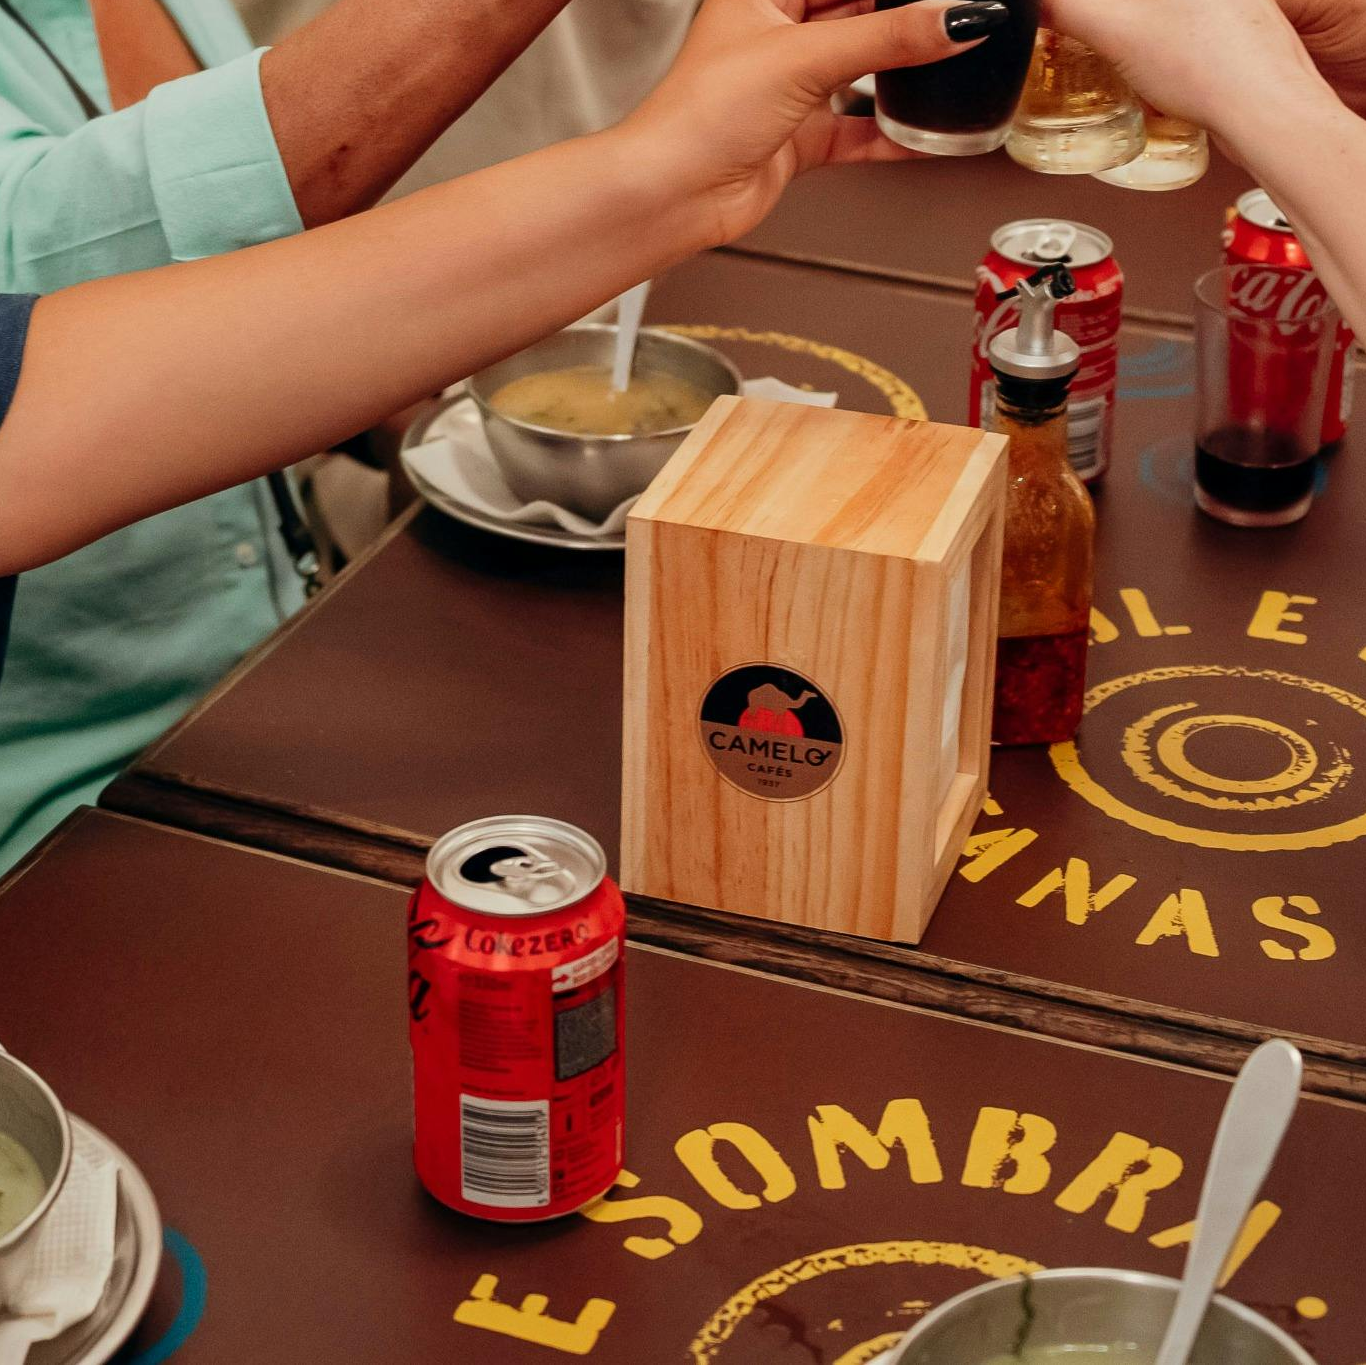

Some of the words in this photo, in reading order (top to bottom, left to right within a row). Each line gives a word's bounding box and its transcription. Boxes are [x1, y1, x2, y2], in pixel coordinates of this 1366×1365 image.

[1247, 589, 1318, 646] E
[747, 762, 793, 778] CAFÉS
[452, 1272, 618, 1355] E
